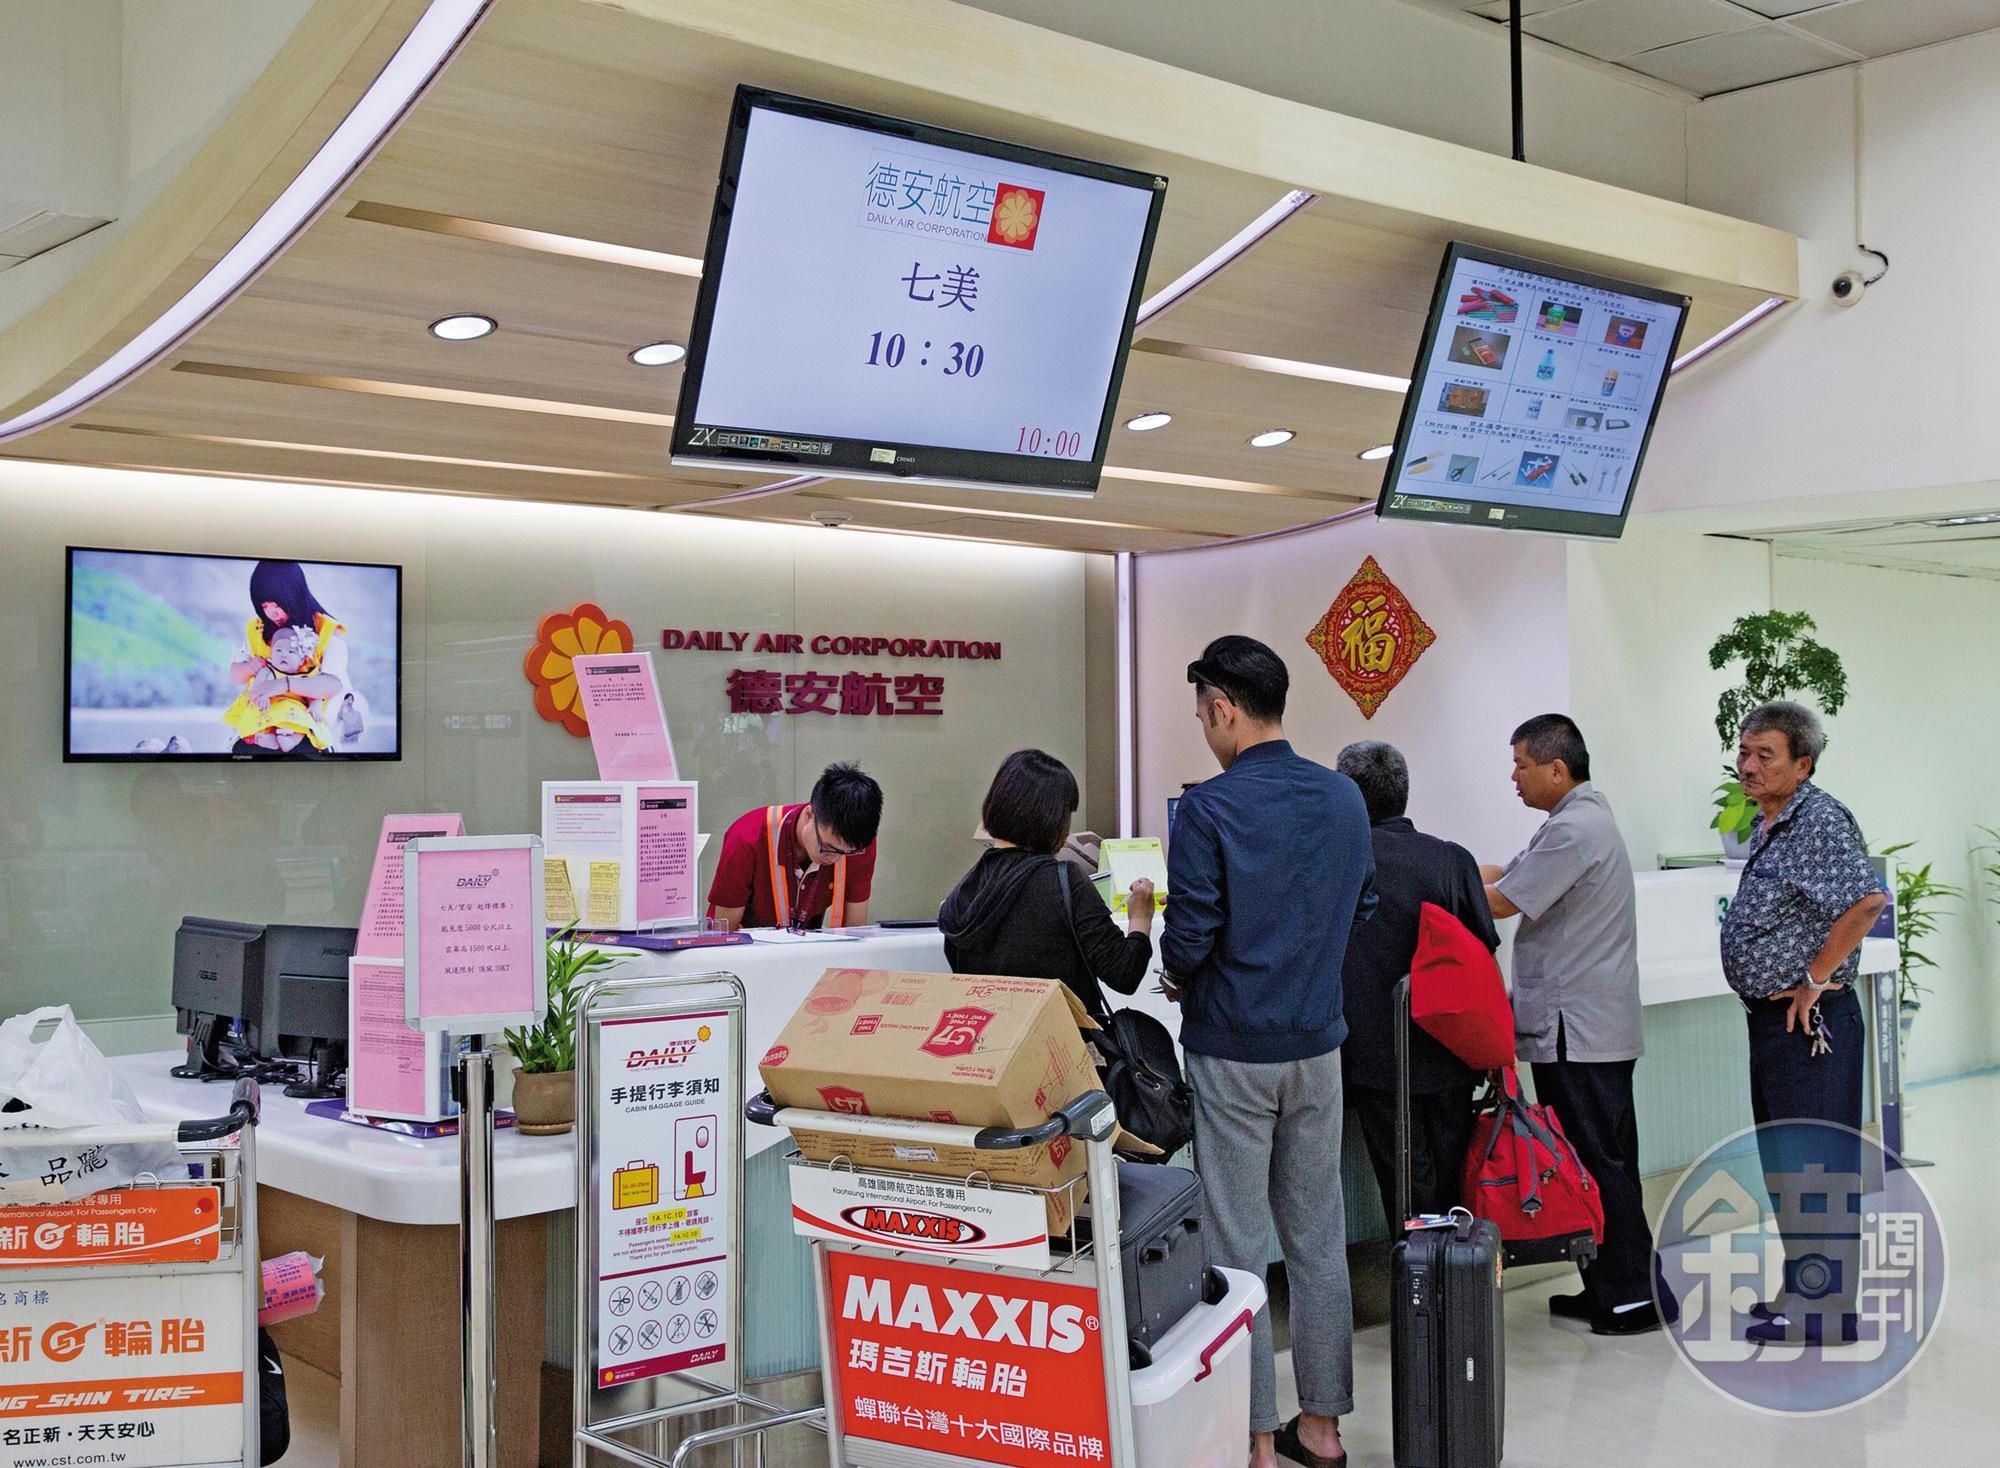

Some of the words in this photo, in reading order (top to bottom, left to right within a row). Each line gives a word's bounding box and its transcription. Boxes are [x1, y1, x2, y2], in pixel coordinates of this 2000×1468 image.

[865, 161, 996, 225] 德安航空
[867, 212, 898, 227] DAILY
[897, 218, 915, 228] AIR
[916, 221, 988, 242] CORPORATION
[901, 262, 981, 313] 七美
[1015, 426, 1081, 458] 10:00
[662, 629, 750, 651] DAILY
[753, 633, 804, 654] AIR
[811, 635, 1001, 660] CORPORATION
[1340, 595, 1396, 673] 福
[726, 669, 945, 716] 德安航空
[456, 877, 492, 888] DAILY
[930, 1026, 977, 1046] G7
[626, 1045, 696, 1068] DAILY
[610, 1078, 720, 1105] 手提行李須知
[625, 1105, 648, 1113] CABIN
[648, 1101, 682, 1110] BAGGAGE
[684, 1098, 706, 1107] GUIDE
[832, 1186, 865, 1199] Kaohsiung
[865, 1191, 905, 1203] International
[928, 1199, 939, 1207] For
[939, 1201, 977, 1213] Passengers
[976, 1206, 993, 1215] Only
[857, 1176, 966, 1201] 高雄國際航空站旅客專用
[91, 1208, 136, 1216] Passengers
[863, 1207, 962, 1243] MAXXIS
[0, 1225, 29, 1250] 新
[76, 1222, 145, 1247] 輪胎
[842, 1274, 1086, 1354] MAXXIS
[0, 1326, 33, 1363] 新
[104, 1317, 205, 1357] 輪胎
[690, 1349, 719, 1363] DAILY
[848, 1338, 1029, 1398] 瑪吉斯輪胎
[36, 1390, 113, 1409] SHIN
[123, 1386, 206, 1403] TIRE
[854, 1395, 1105, 1461] 蟬聯台灣十大國際品牌
[13, 1451, 127, 1468] www.cst.com.tw
